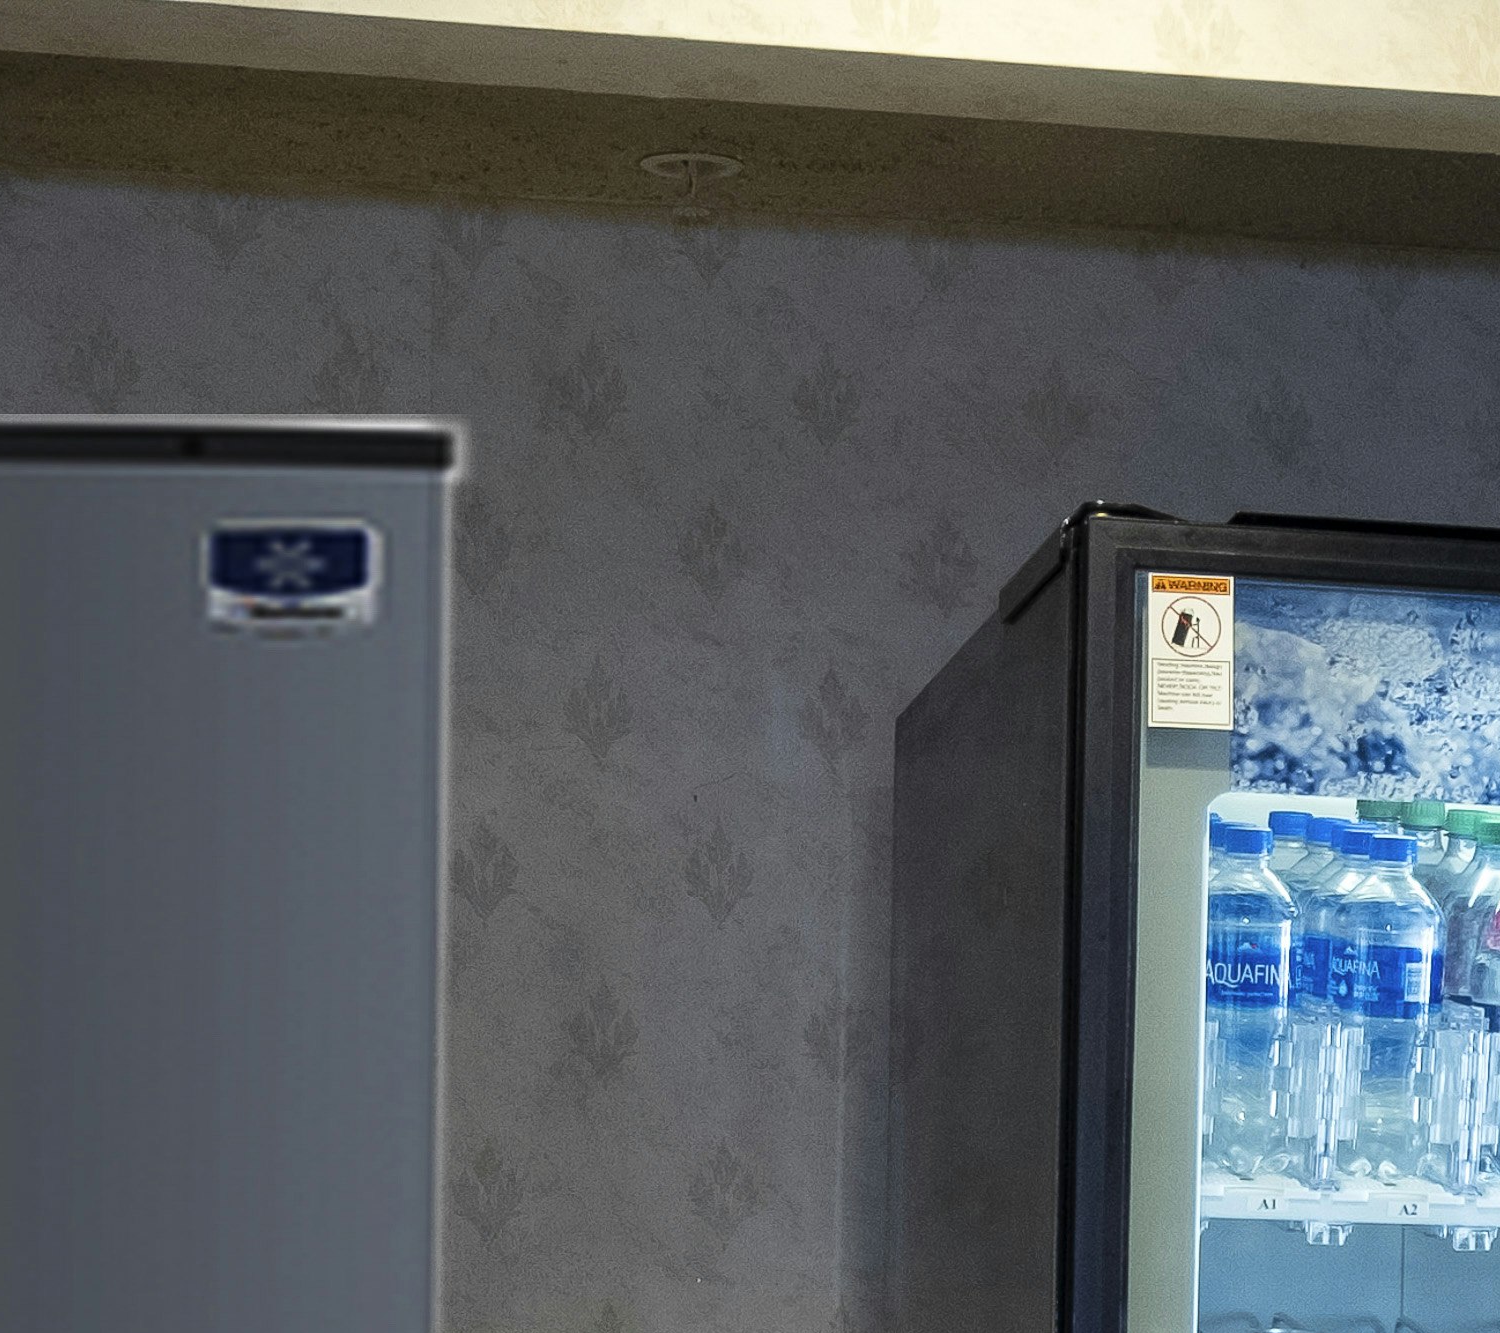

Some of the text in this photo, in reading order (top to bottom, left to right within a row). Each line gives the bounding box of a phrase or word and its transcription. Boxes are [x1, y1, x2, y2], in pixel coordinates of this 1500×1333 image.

[1168, 580, 1228, 592] WARNING
[1206, 957, 1293, 988] AQUAFIN
[1257, 1198, 1277, 1210] A1
[1398, 1204, 1418, 1216] A2
